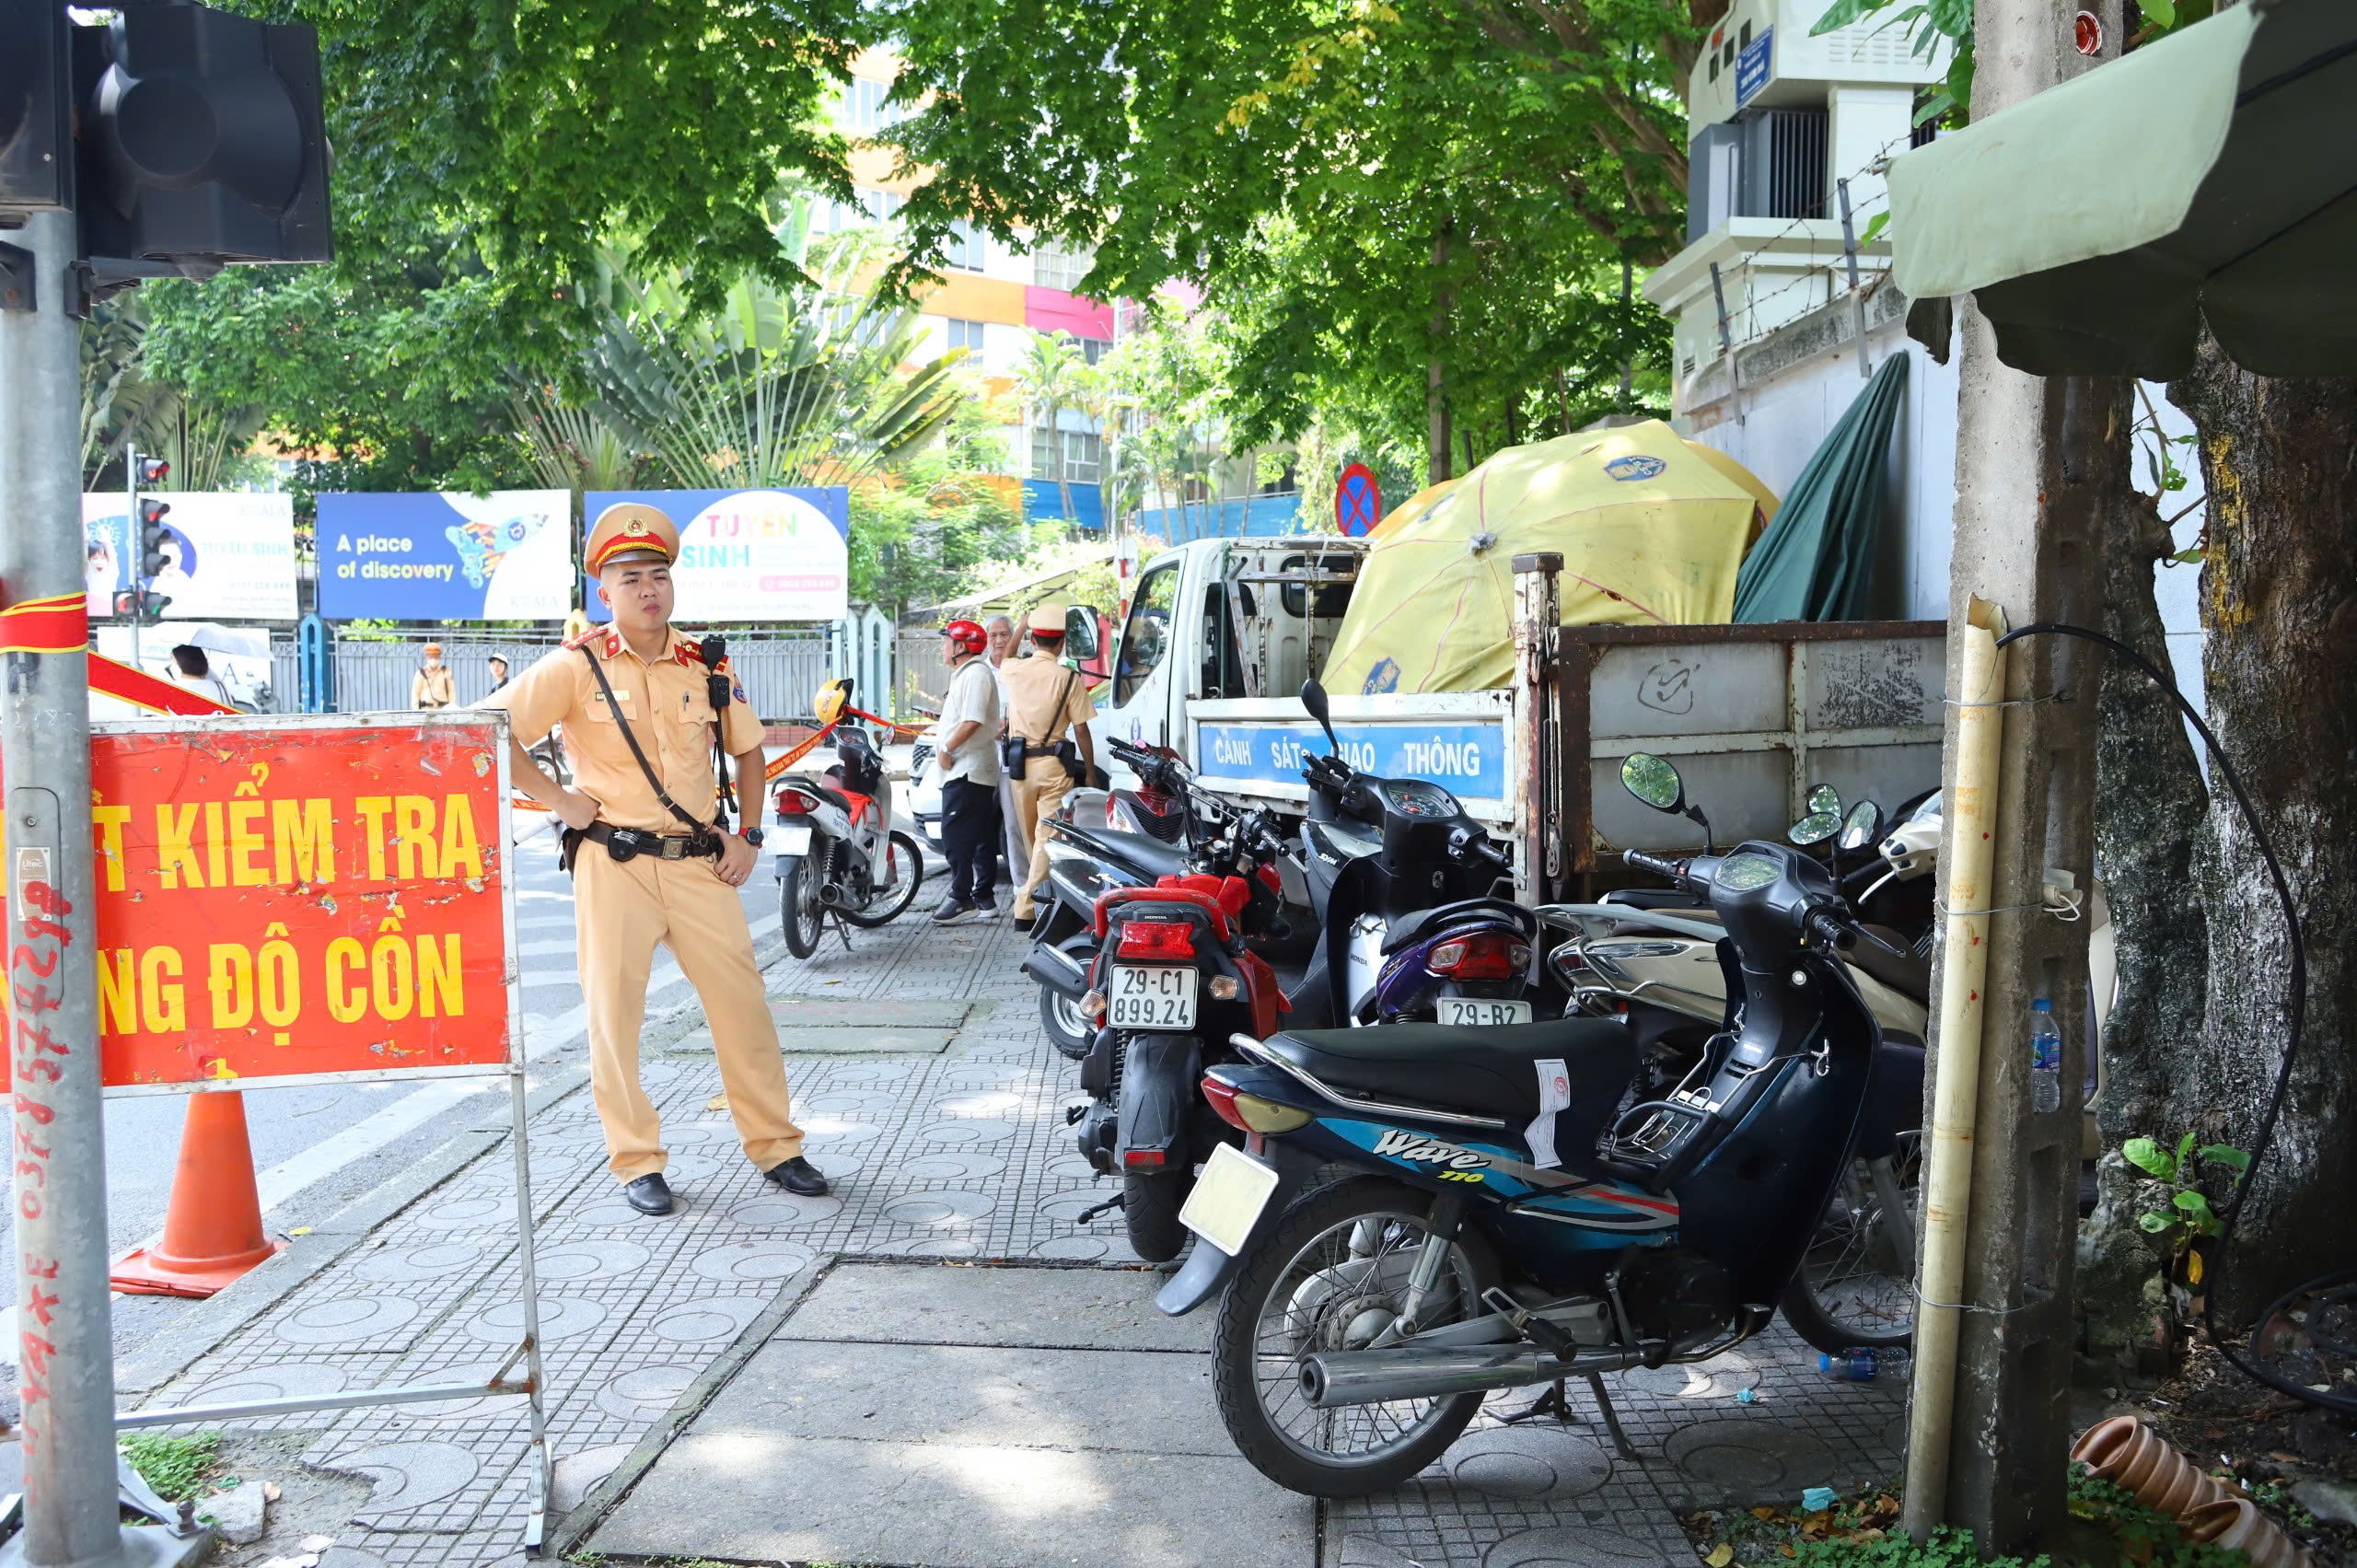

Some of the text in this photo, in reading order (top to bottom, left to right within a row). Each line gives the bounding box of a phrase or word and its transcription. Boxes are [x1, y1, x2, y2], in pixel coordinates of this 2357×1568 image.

[336, 534, 412, 556] A place
[681, 544, 749, 569] SINH
[337, 561, 454, 582] of discovery
[1271, 734, 1303, 770] SÁT
[1404, 736, 1480, 775] THÔNG
[157, 761, 334, 889] KIỂM
[356, 794, 482, 880] TRA
[1318, 853, 1338, 865] SYM
[1350, 954, 1368, 966] HONDA
[99, 905, 464, 1046] NG ĐỘ CỒN
[1123, 970, 1182, 995] 29-C1
[1114, 998, 1189, 1025] 899.24
[1453, 1004, 1515, 1025] 29-B2
[1372, 1129, 1492, 1169] Wave
[1437, 1170, 1484, 1183] 110
